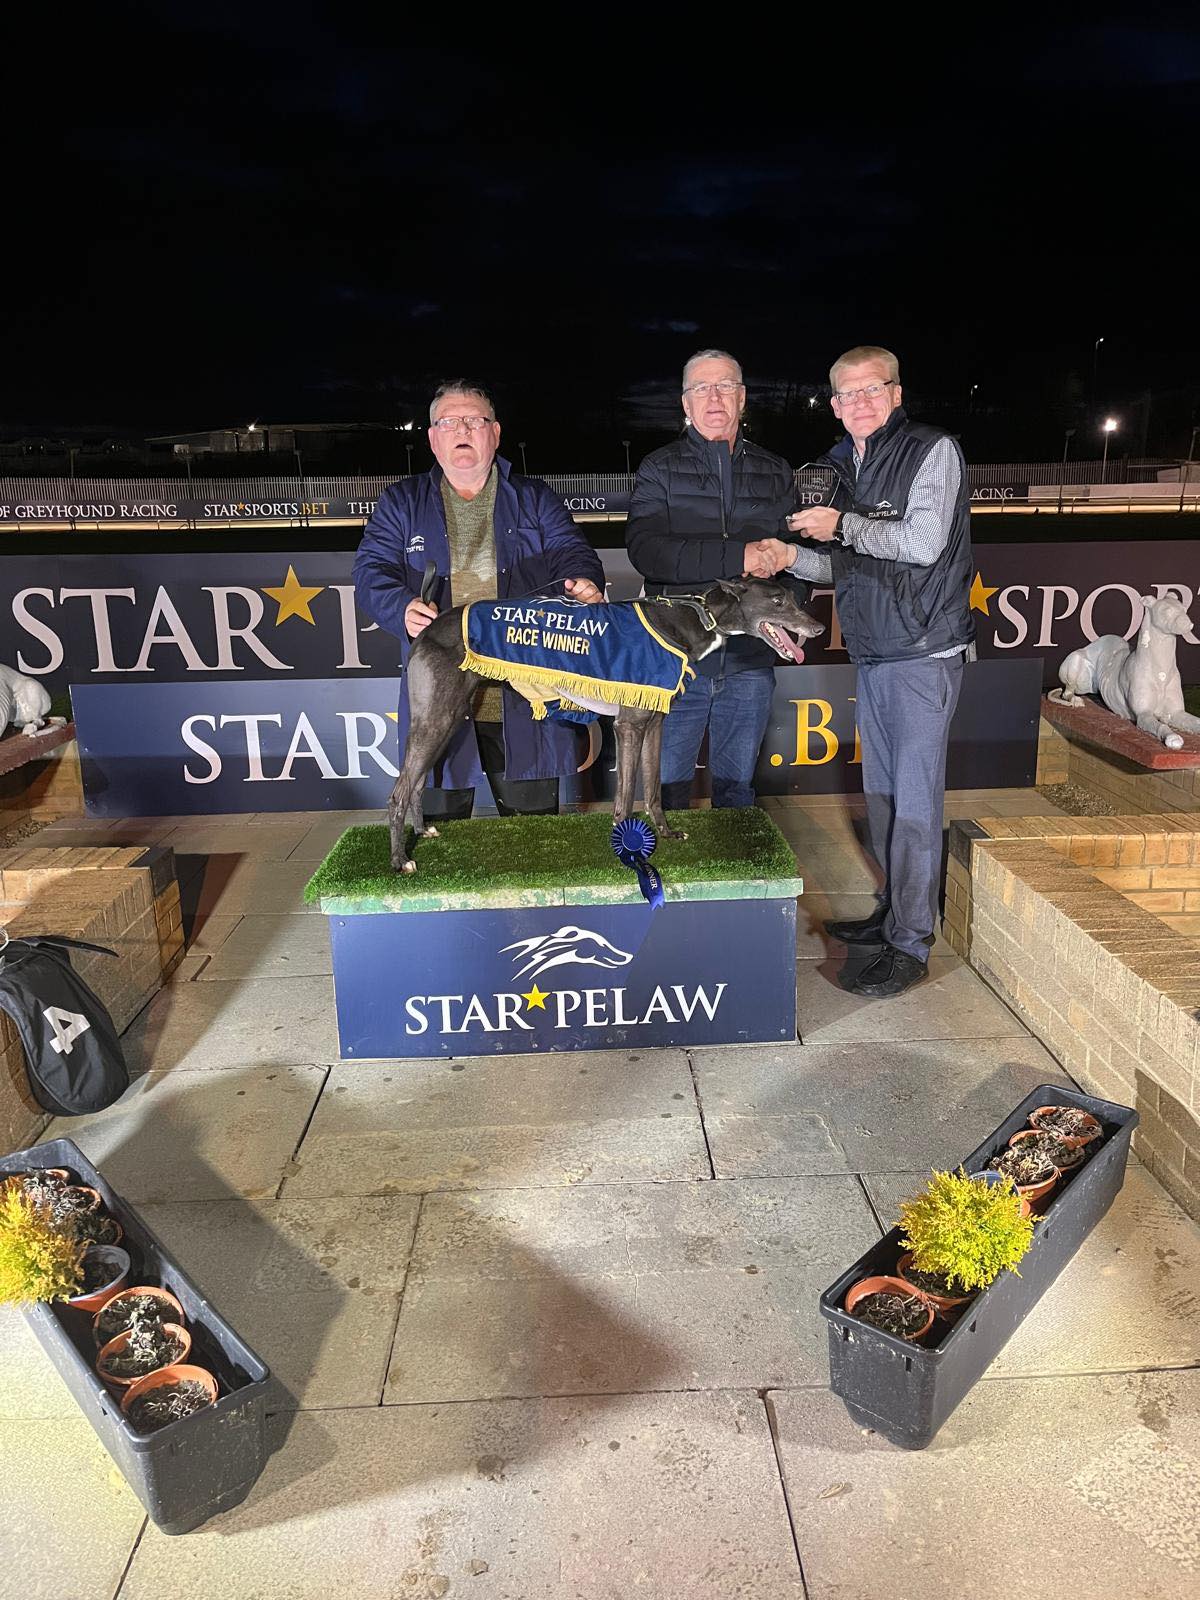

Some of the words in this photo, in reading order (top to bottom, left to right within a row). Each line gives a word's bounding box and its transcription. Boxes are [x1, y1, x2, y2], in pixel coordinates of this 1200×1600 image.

[0, 505, 11, 518] F
[15, 504, 115, 518] GREYHOUND
[120, 504, 178, 517] RACING
[563, 497, 606, 510] ACING
[972, 488, 1014, 499] ACING
[11, 585, 295, 675] STAR
[491, 606, 539, 625] STAR
[545, 612, 609, 637] PELAW
[993, 583, 1200, 649] SPOR
[506, 626, 539, 646] RACE
[542, 630, 590, 655] WINNER
[181, 711, 400, 784] STAR
[405, 993, 535, 1035] STAR
[553, 983, 728, 1029] PELAW
[43, 1006, 91, 1054] 4
